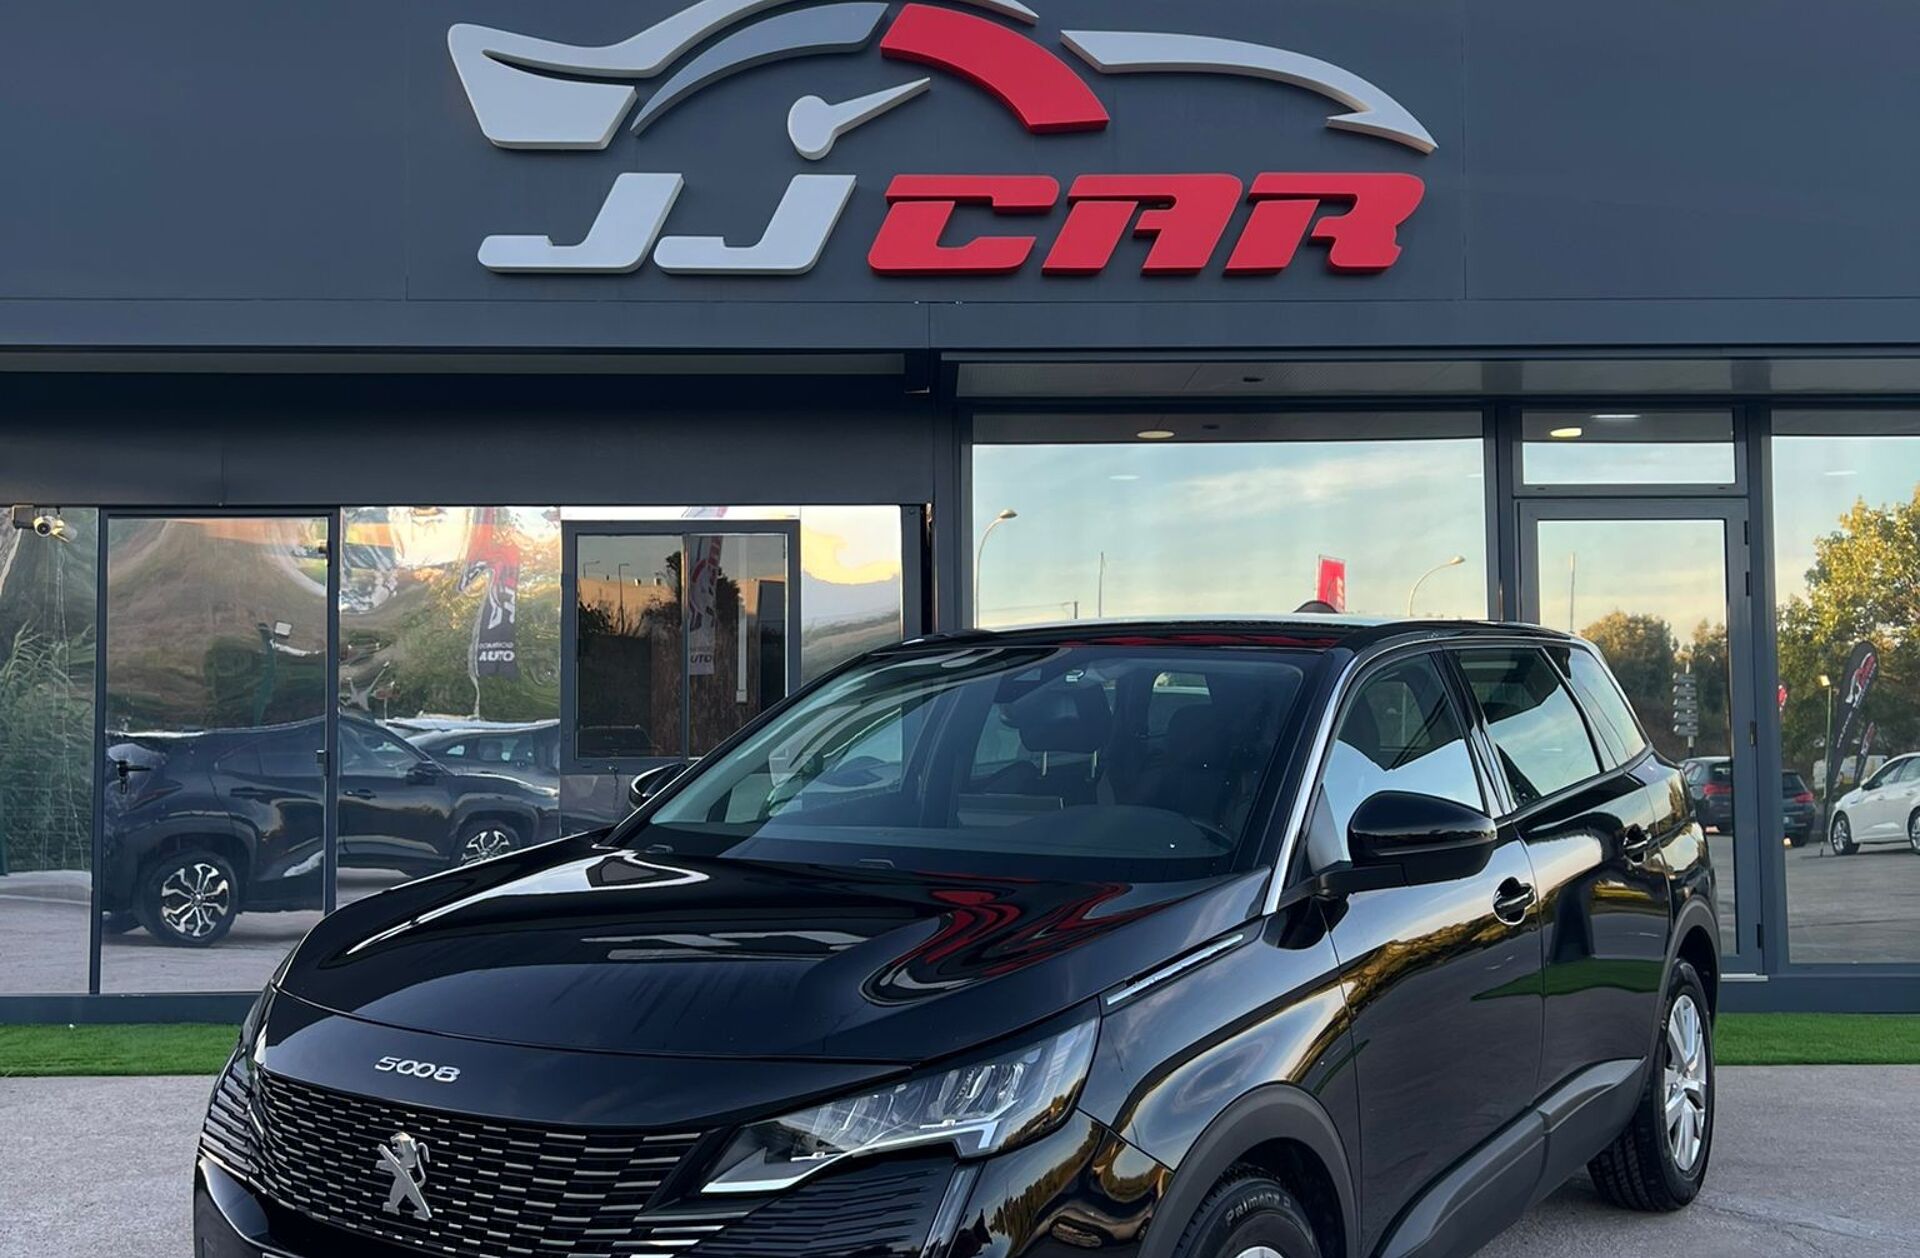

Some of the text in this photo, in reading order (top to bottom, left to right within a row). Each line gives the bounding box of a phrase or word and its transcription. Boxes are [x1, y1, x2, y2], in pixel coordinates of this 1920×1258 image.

[867, 173, 1425, 276] CAR
[479, 650, 515, 662] AUTO
[690, 654, 713, 664] UTO
[374, 1056, 461, 1082] 5008
